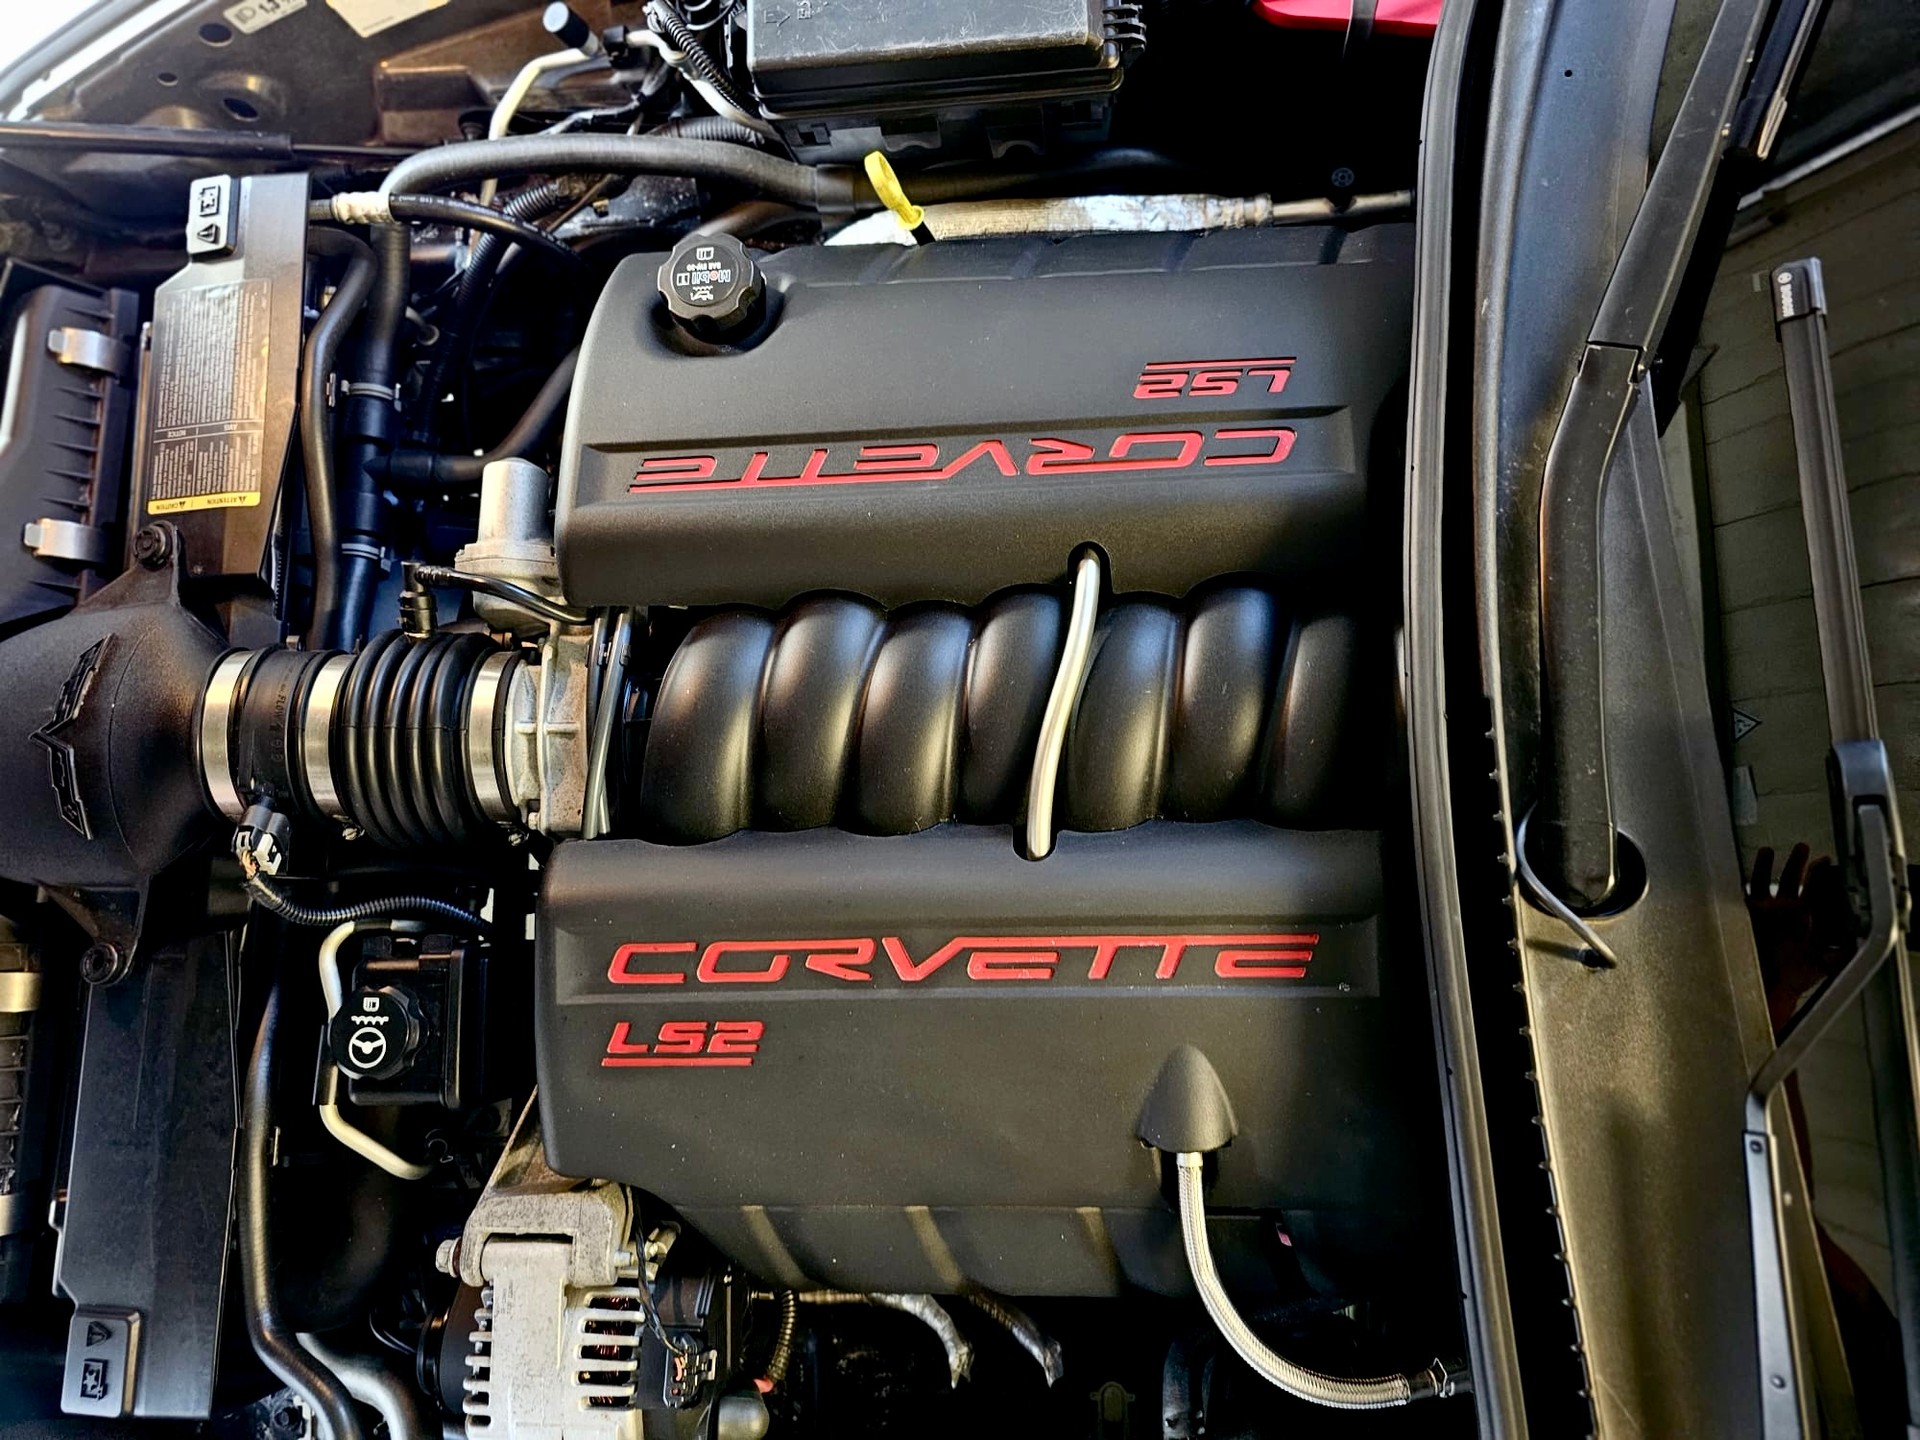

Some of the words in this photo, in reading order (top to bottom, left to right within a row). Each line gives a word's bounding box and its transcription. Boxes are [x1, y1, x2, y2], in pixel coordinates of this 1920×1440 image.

[691, 269, 731, 285] Mobil
[1133, 366, 1294, 399] LS2
[628, 429, 1297, 493] CORVETTE
[608, 934, 1319, 983] CORVETTE
[606, 1020, 764, 1054] LS2
